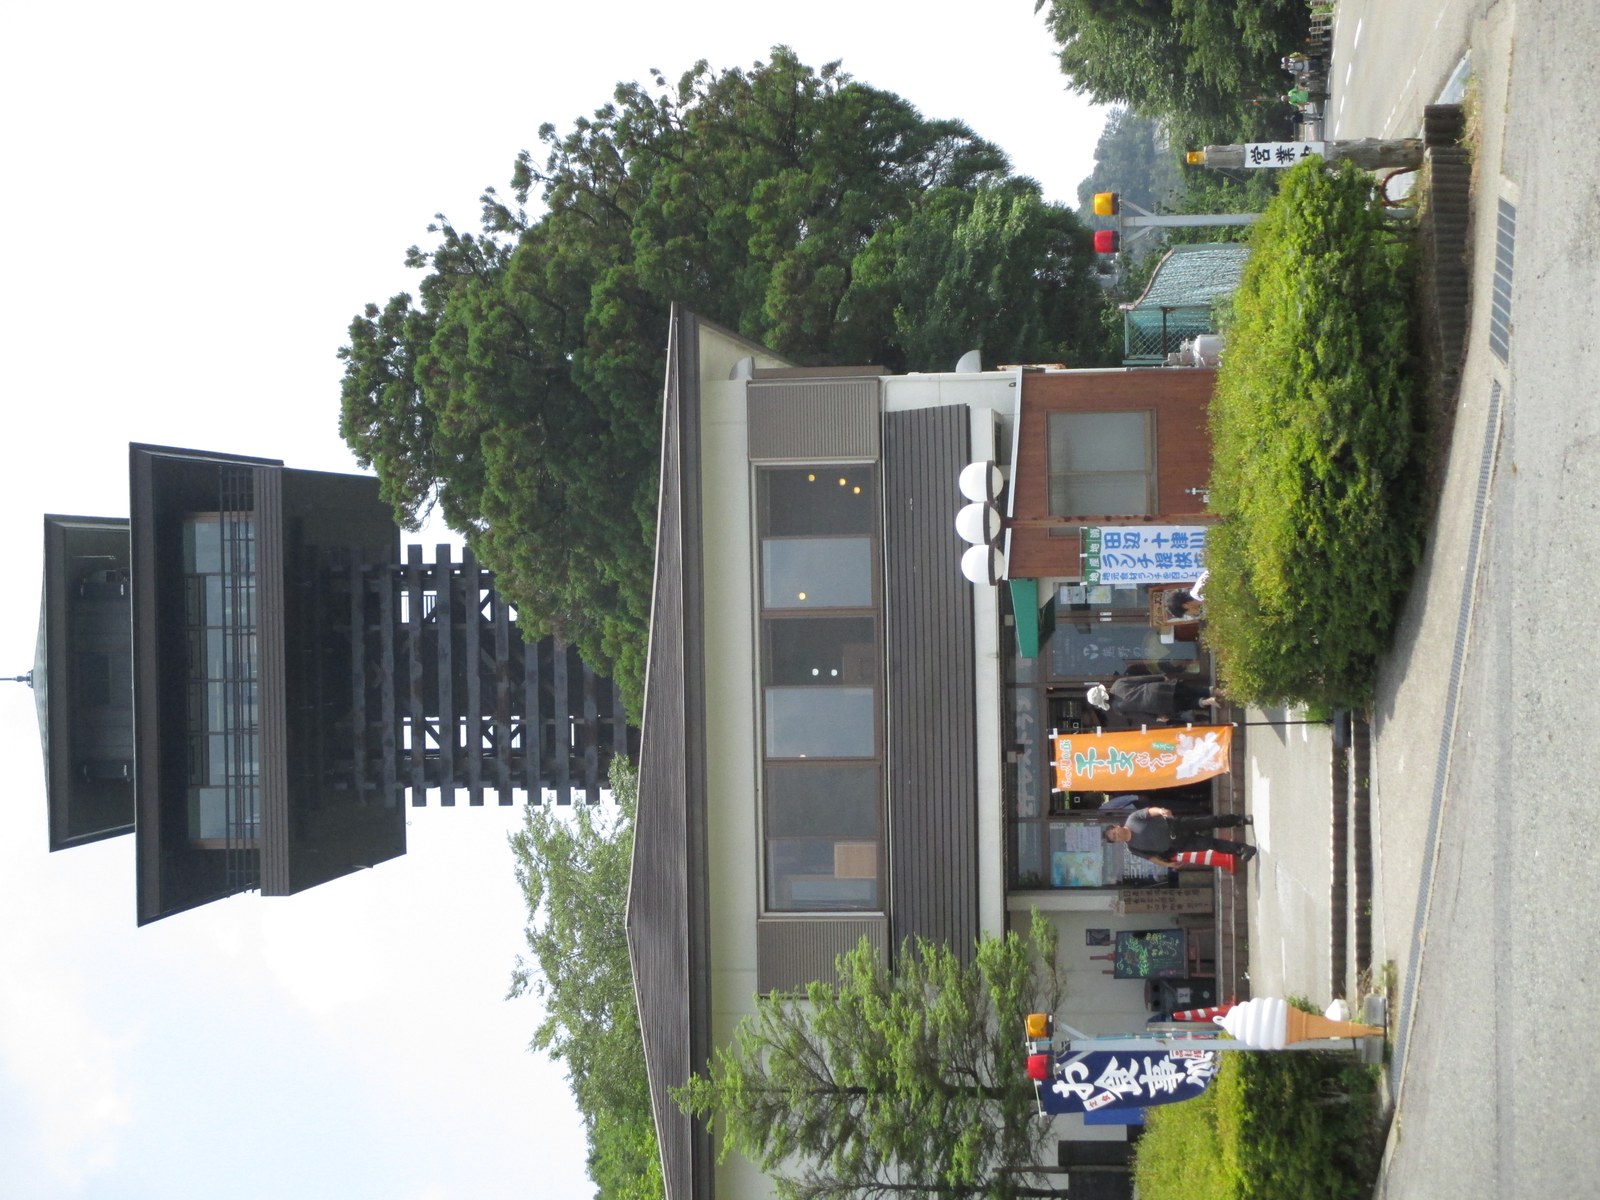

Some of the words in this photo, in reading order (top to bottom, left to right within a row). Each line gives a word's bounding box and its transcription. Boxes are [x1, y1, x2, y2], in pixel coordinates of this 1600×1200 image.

[1087, 528, 1100, 582] 地産地消
[1101, 571, 1205, 581] 地元食材ランチを召し上
[1052, 1051, 1215, 1100] お食事処
